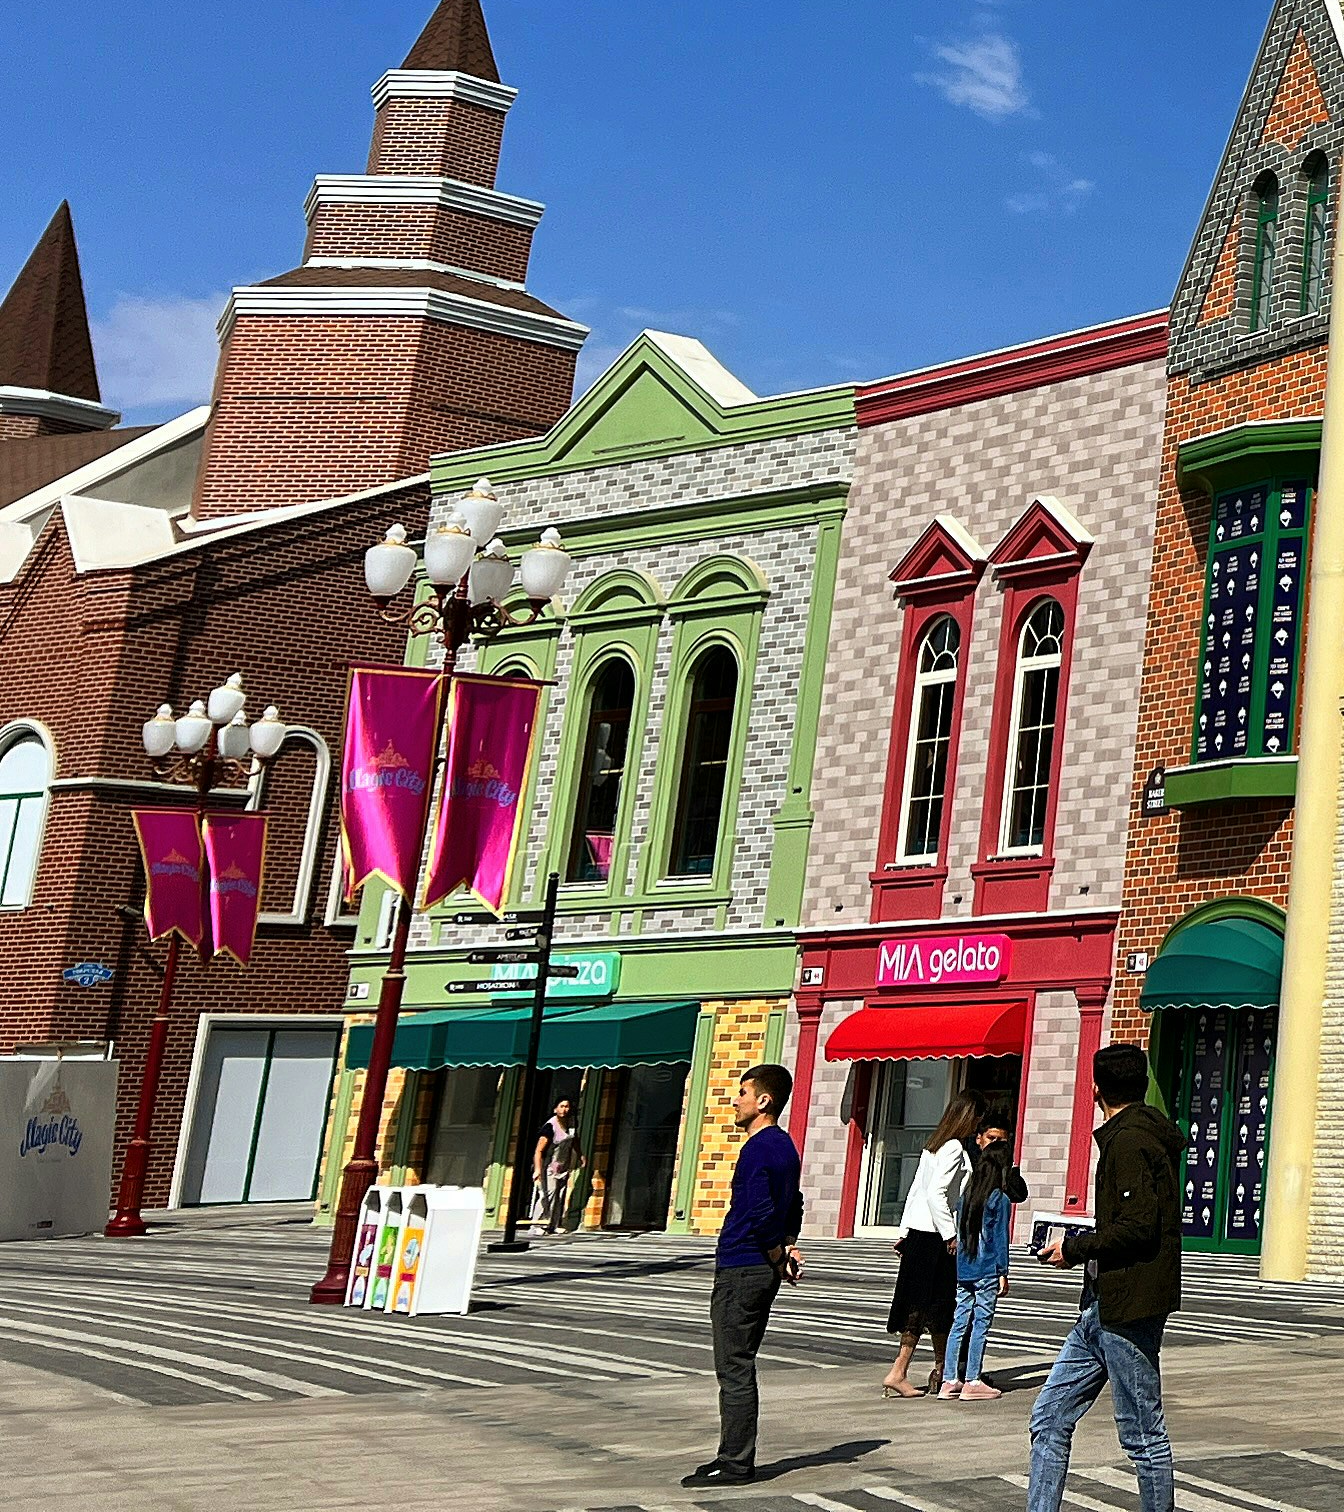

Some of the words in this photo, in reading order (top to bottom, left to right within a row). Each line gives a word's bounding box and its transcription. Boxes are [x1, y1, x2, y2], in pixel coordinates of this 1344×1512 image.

[395, 766, 427, 796] City
[484, 779, 517, 807] City
[492, 960, 534, 982] MIA
[878, 943, 925, 981] MIA
[929, 938, 1000, 983] gelato
[20, 1115, 59, 1157] Magic
[59, 1114, 83, 1156] City
